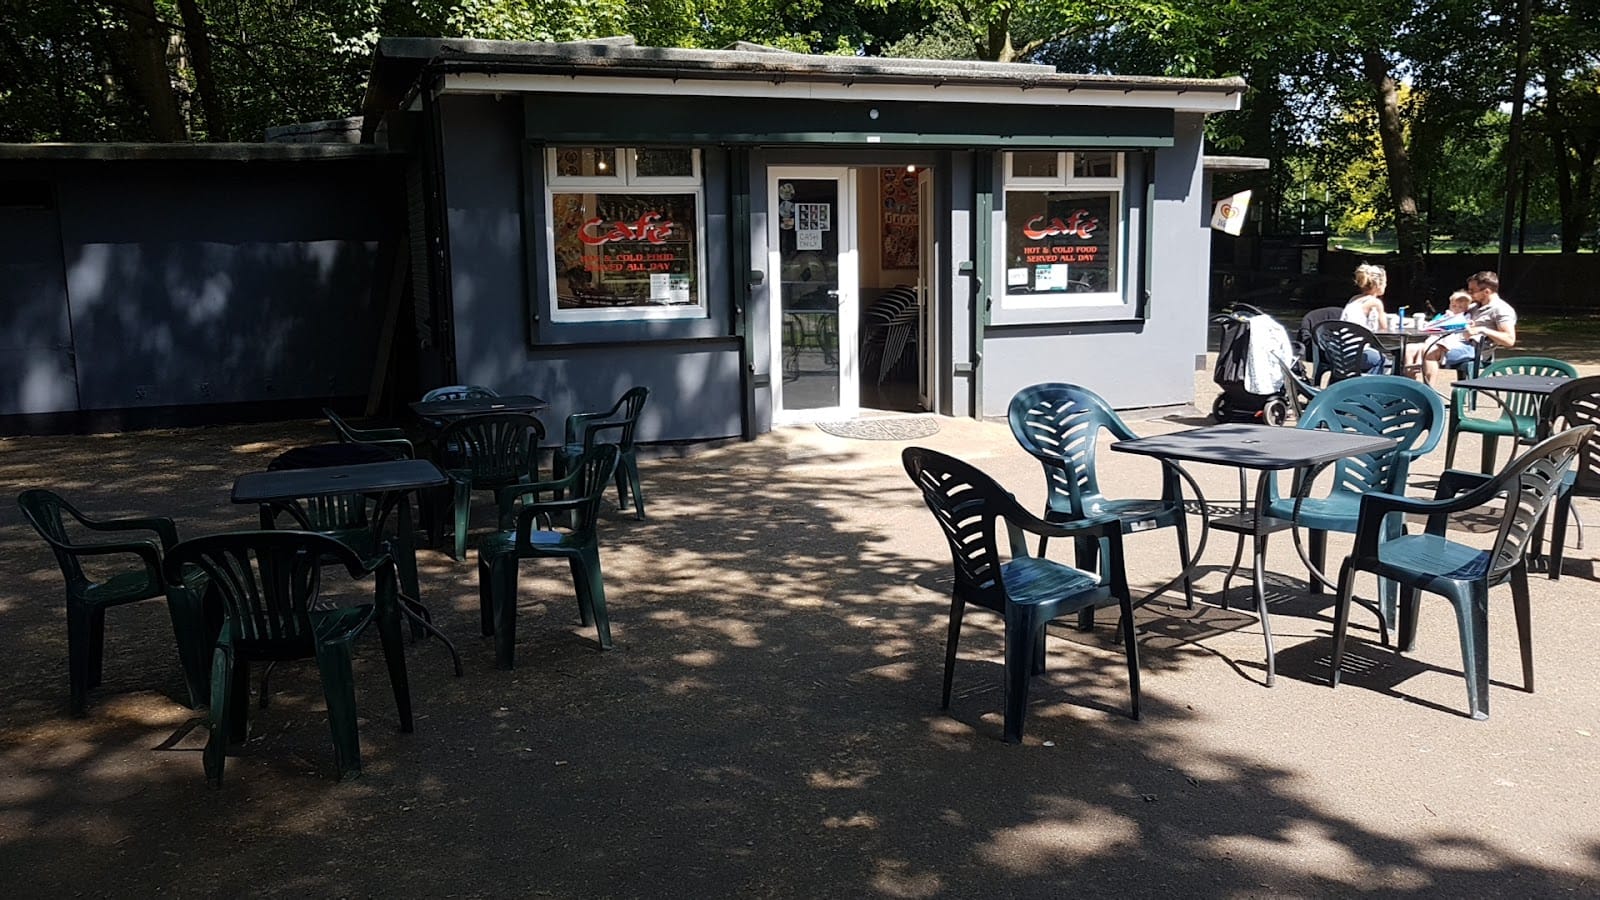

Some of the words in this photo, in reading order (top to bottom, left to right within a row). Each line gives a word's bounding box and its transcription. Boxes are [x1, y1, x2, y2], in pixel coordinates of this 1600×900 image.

[578, 211, 674, 245] Café
[1023, 209, 1099, 240] Café
[1052, 246, 1073, 254] COLD
[616, 254, 643, 262] COLD
[1060, 254, 1075, 262] ALL
[627, 263, 646, 271] ALL
[650, 262, 670, 270] DAY
